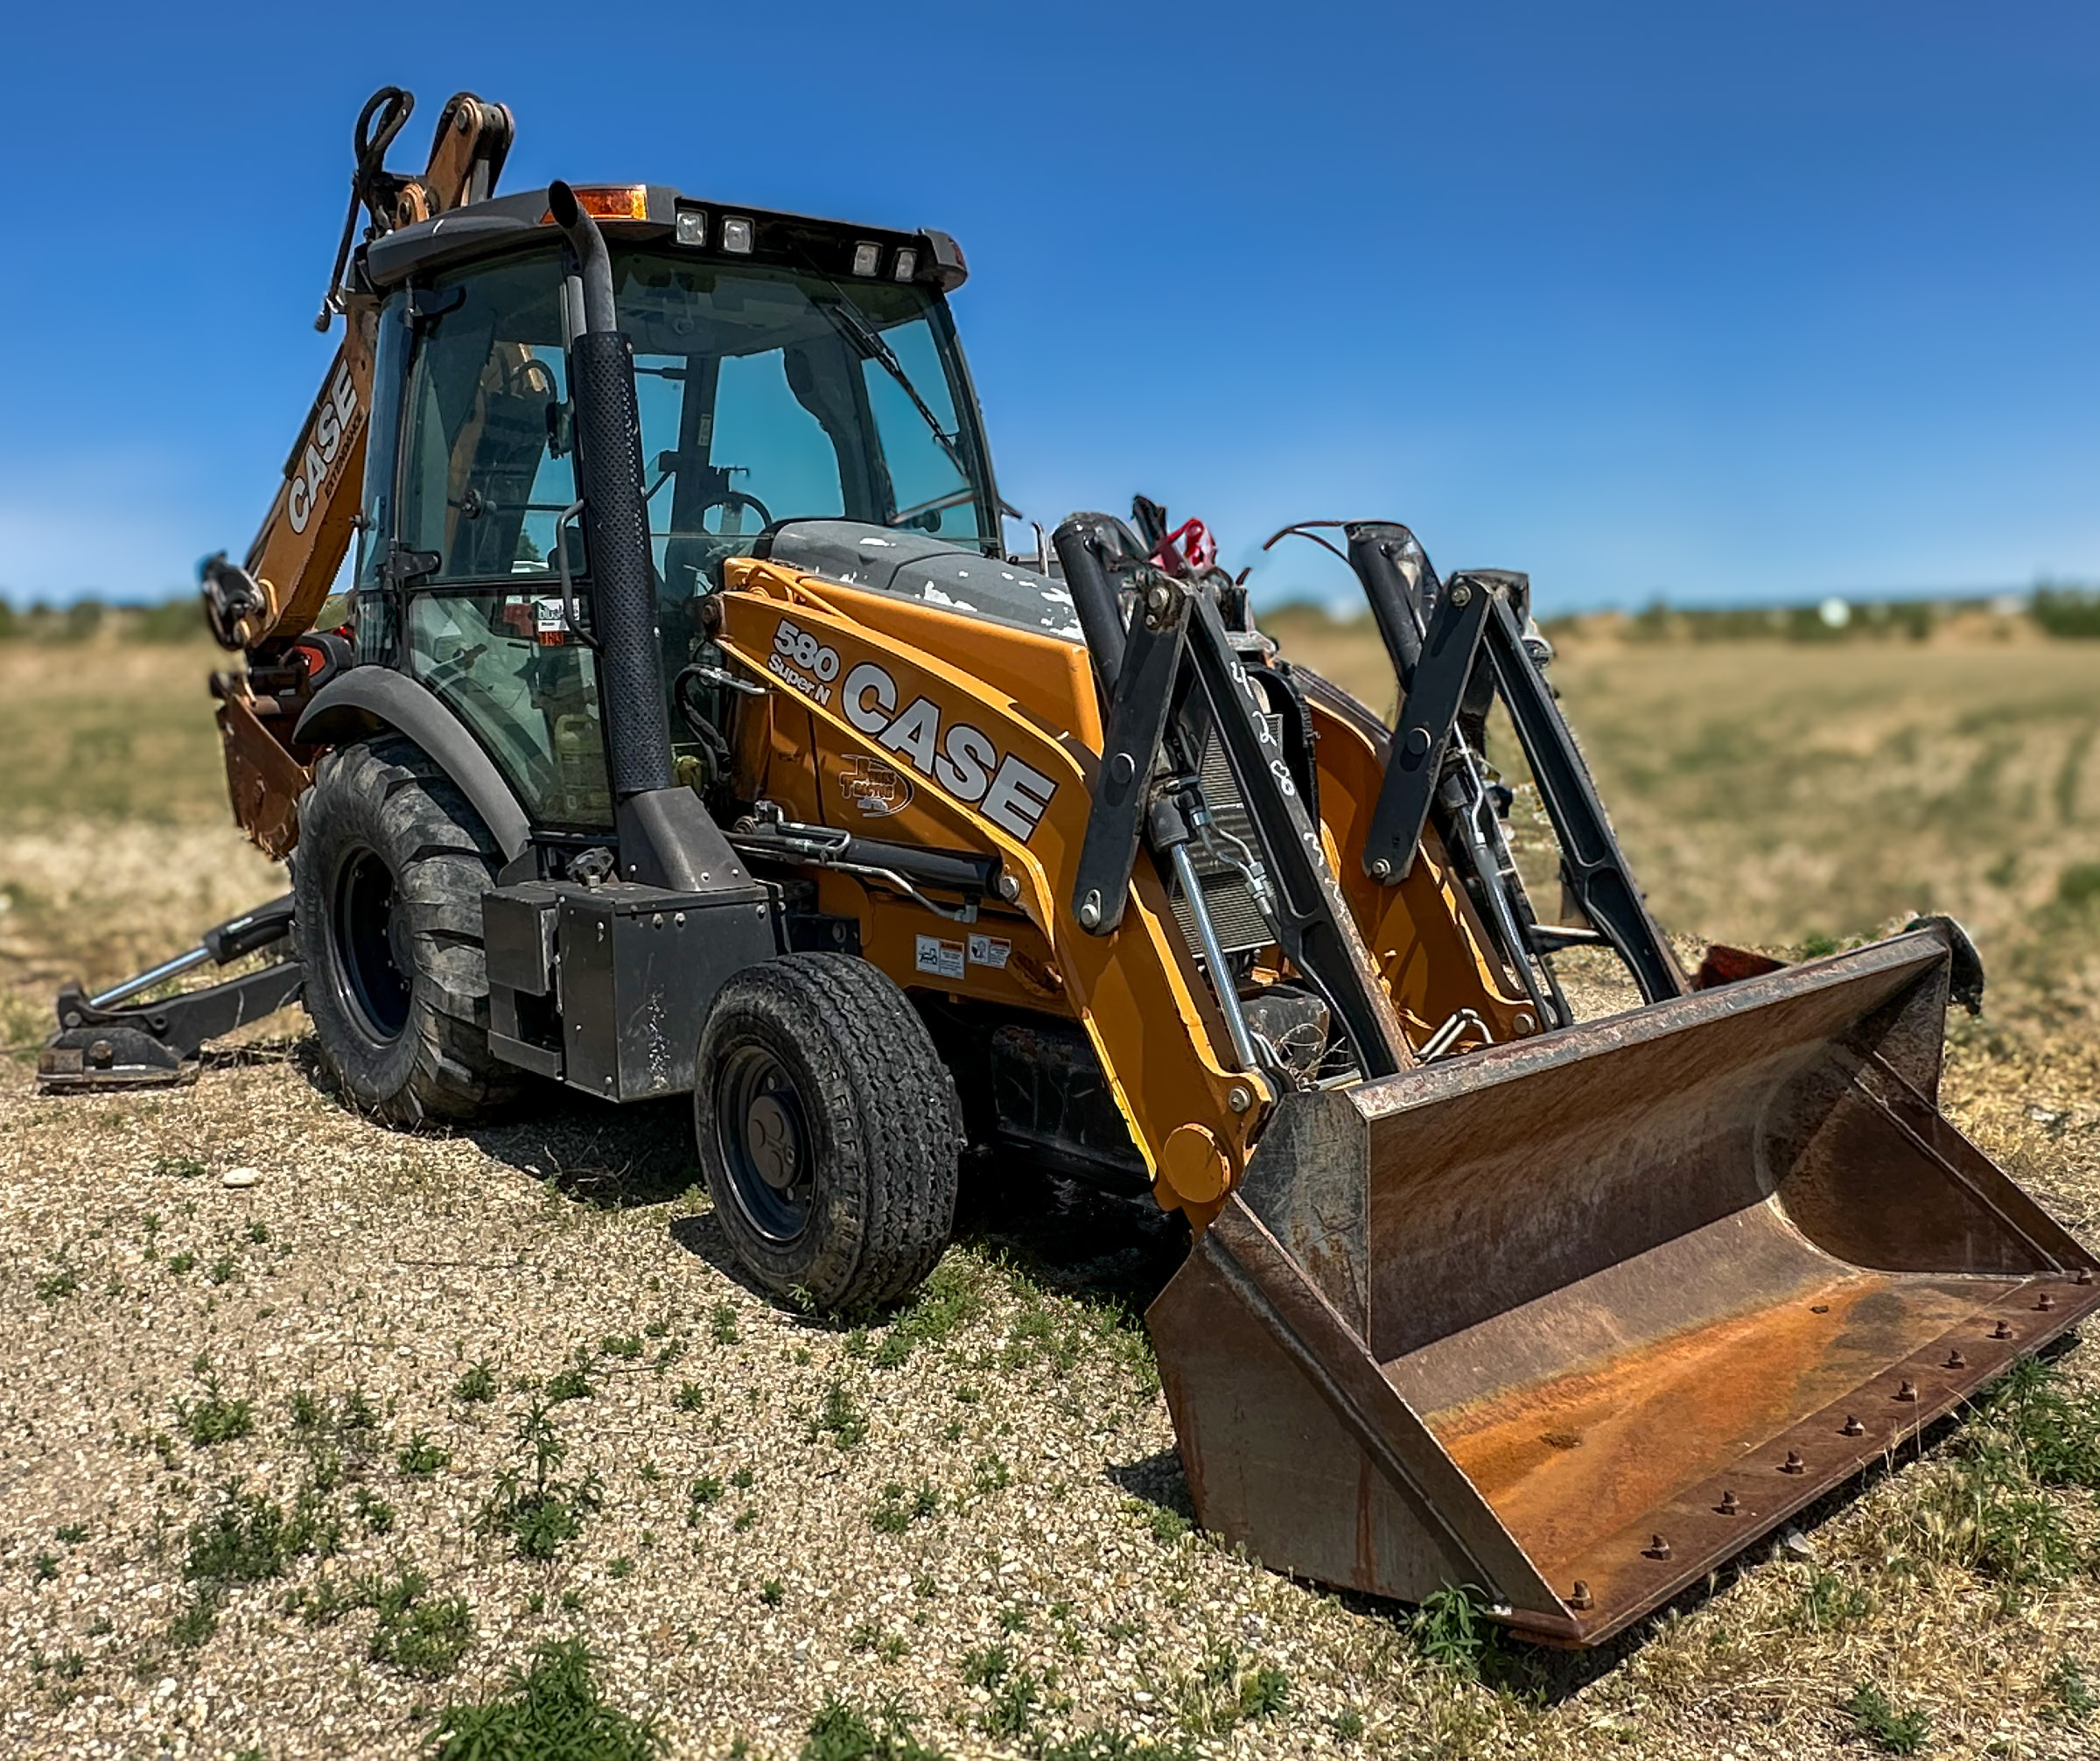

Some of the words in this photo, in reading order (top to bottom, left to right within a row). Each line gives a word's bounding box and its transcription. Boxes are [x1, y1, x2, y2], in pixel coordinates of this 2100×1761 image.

[289, 358, 358, 534] CASE
[768, 652, 815, 694] Super
[814, 684, 832, 706] N
[773, 617, 840, 683] 580
[843, 663, 1059, 843] CASE
